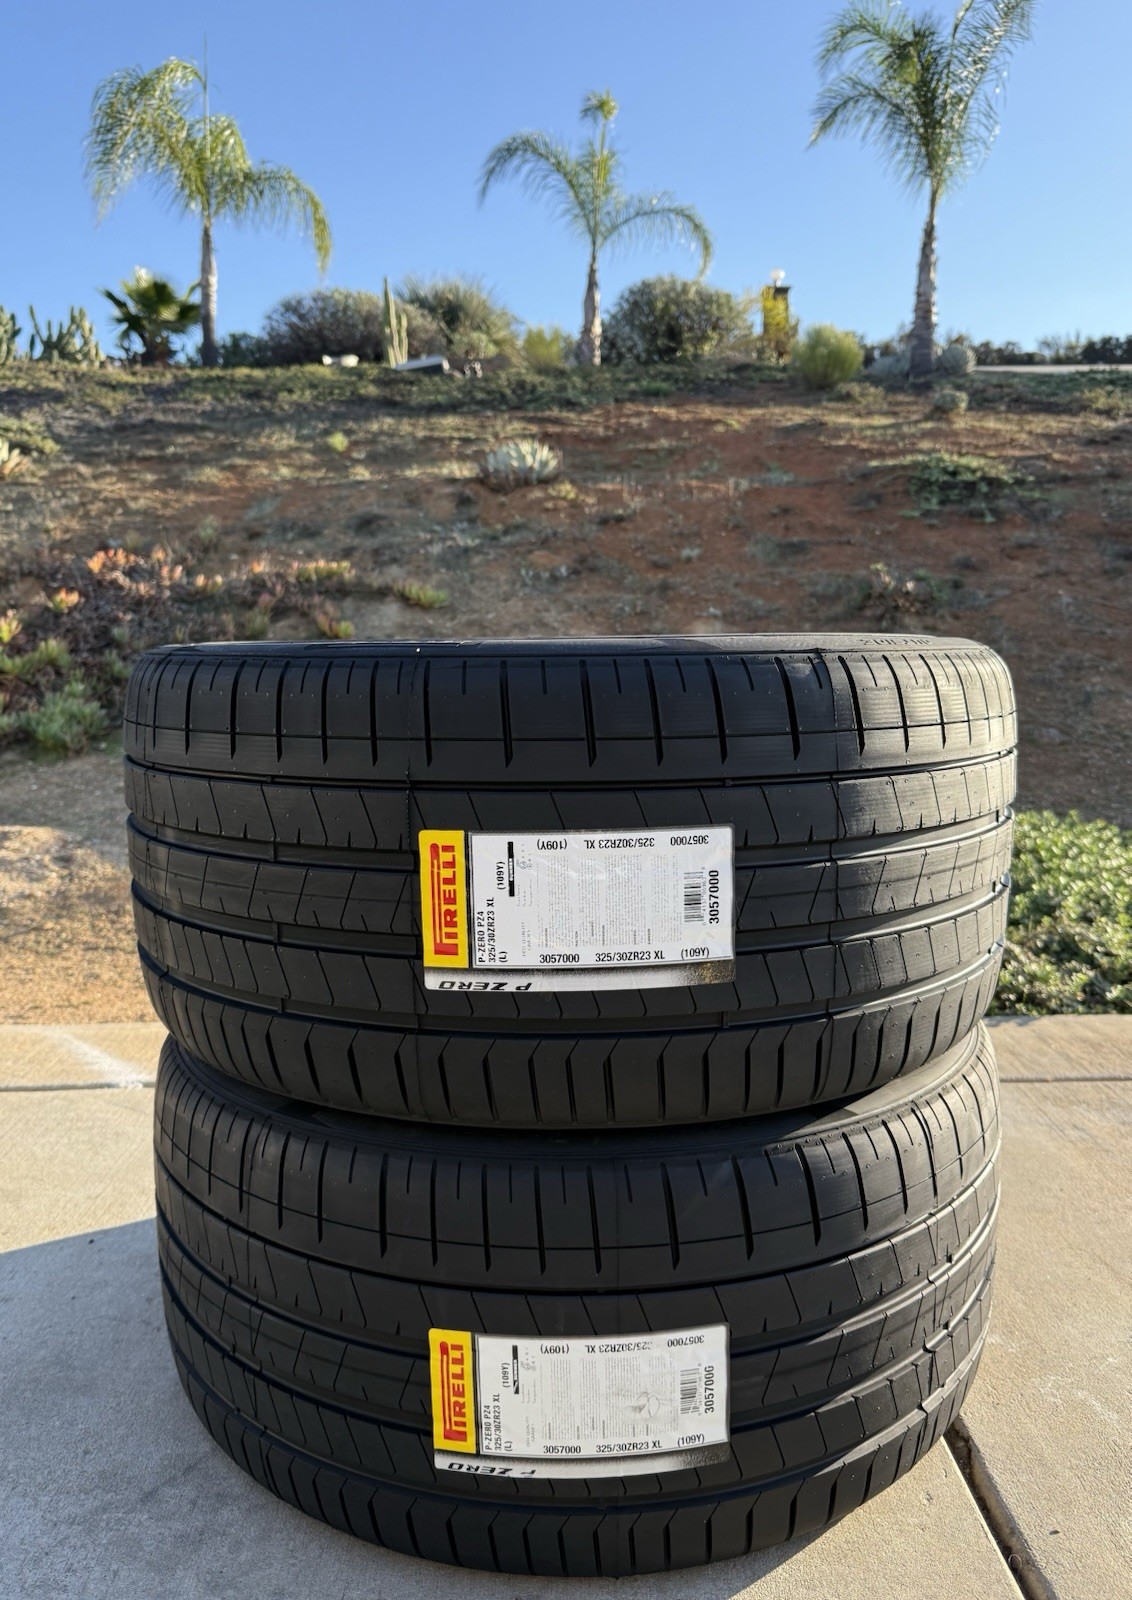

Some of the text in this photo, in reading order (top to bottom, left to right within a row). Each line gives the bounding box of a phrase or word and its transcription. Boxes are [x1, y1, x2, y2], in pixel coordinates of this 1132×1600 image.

[536, 834, 709, 850] 3057000 325/30ZR23 XL (109Y)
[430, 843, 459, 956] PIRELLI
[496, 861, 508, 963] (L) (109Y)
[708, 870, 720, 924] 3057000
[476, 911, 486, 963] P-ZERO PZ4
[486, 897, 496, 963] 325/30ZR23 XL
[539, 947, 710, 964] 3057000 325/30ZR23 XL (109Y)
[438, 980, 533, 991] P ZERO
[540, 1343, 570, 1354] (109Y)
[584, 1344, 596, 1353] XL
[667, 1334, 705, 1348] 3057000
[439, 1340, 468, 1443] PIRELLI
[501, 1362, 513, 1452] (L) (109Y)
[483, 1404, 493, 1451] P-ZERO PZ4
[493, 1393, 502, 1452] 325/30ZR23 XL
[543, 1434, 705, 1455] 3057000 325/30ZR23 XL (109Y)
[447, 1462, 513, 1475] ZERO
